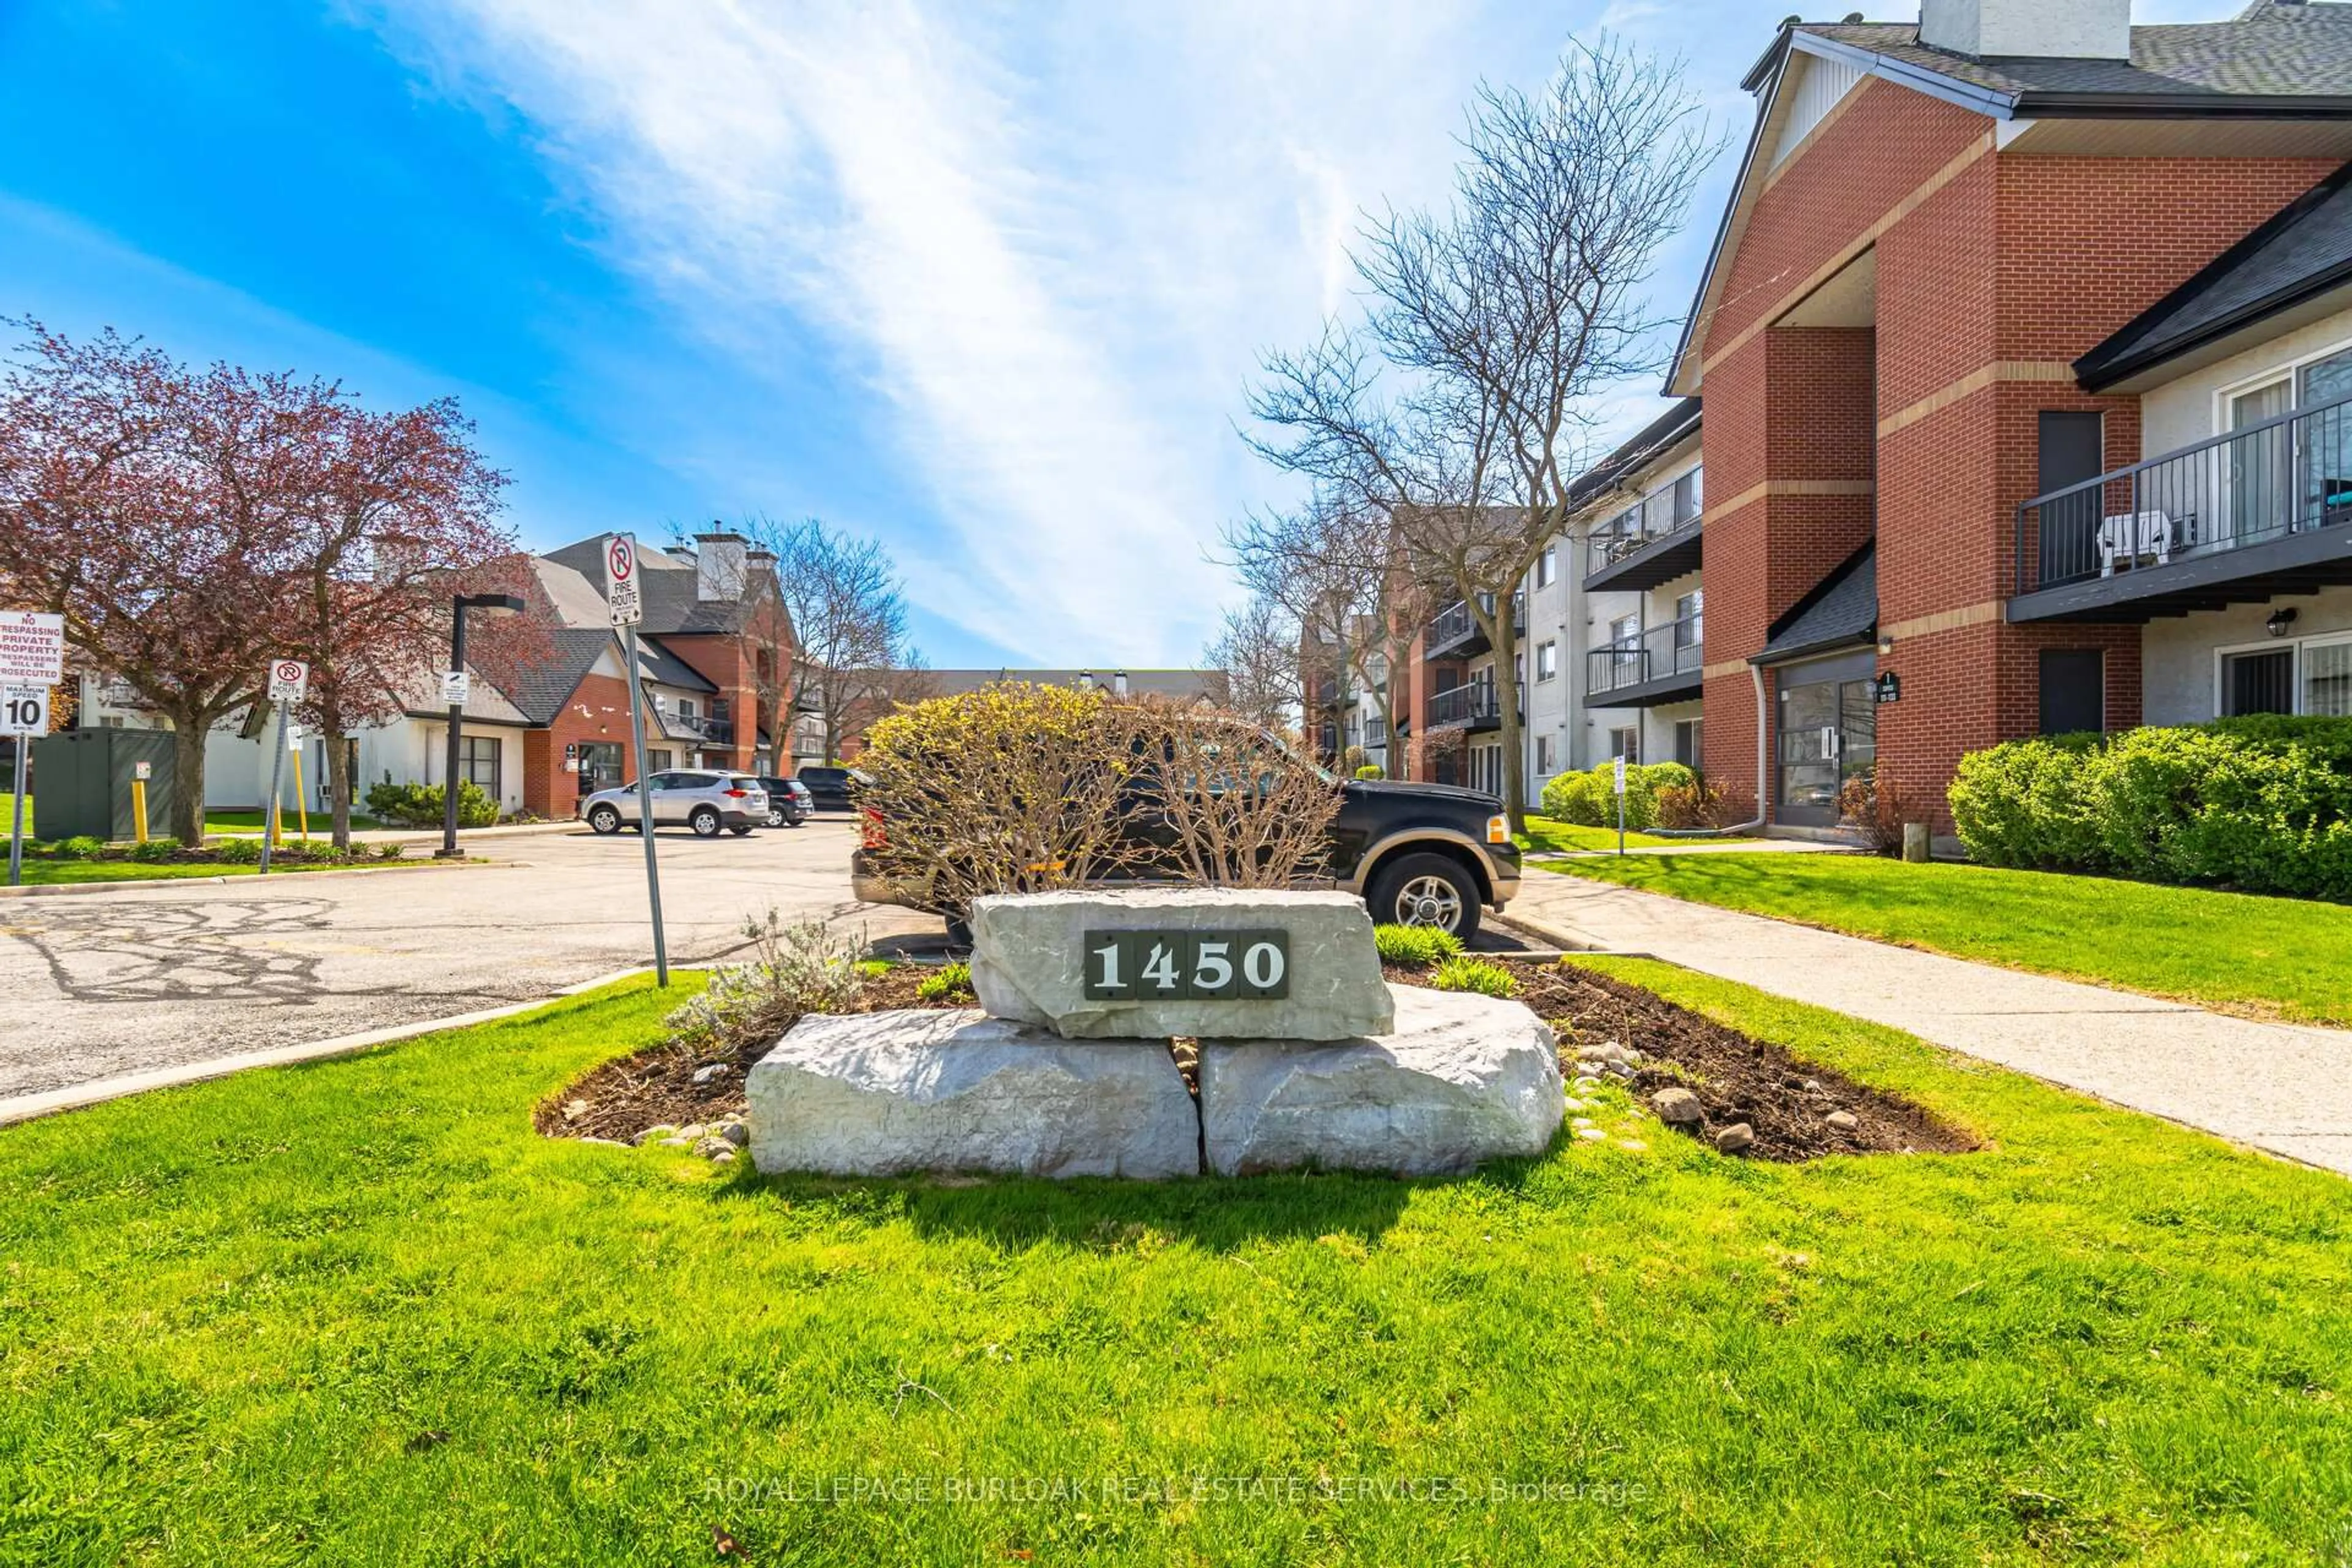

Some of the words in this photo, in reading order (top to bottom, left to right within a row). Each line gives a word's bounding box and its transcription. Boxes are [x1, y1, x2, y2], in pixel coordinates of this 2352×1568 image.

[614, 581, 632, 594] FIRE
[611, 592, 638, 607] ROUTE
[2, 635, 53, 645] PRIVATE
[0, 668, 57, 678] ROSECUTED
[6, 699, 40, 725] 10
[1093, 942, 1284, 989] 1450
